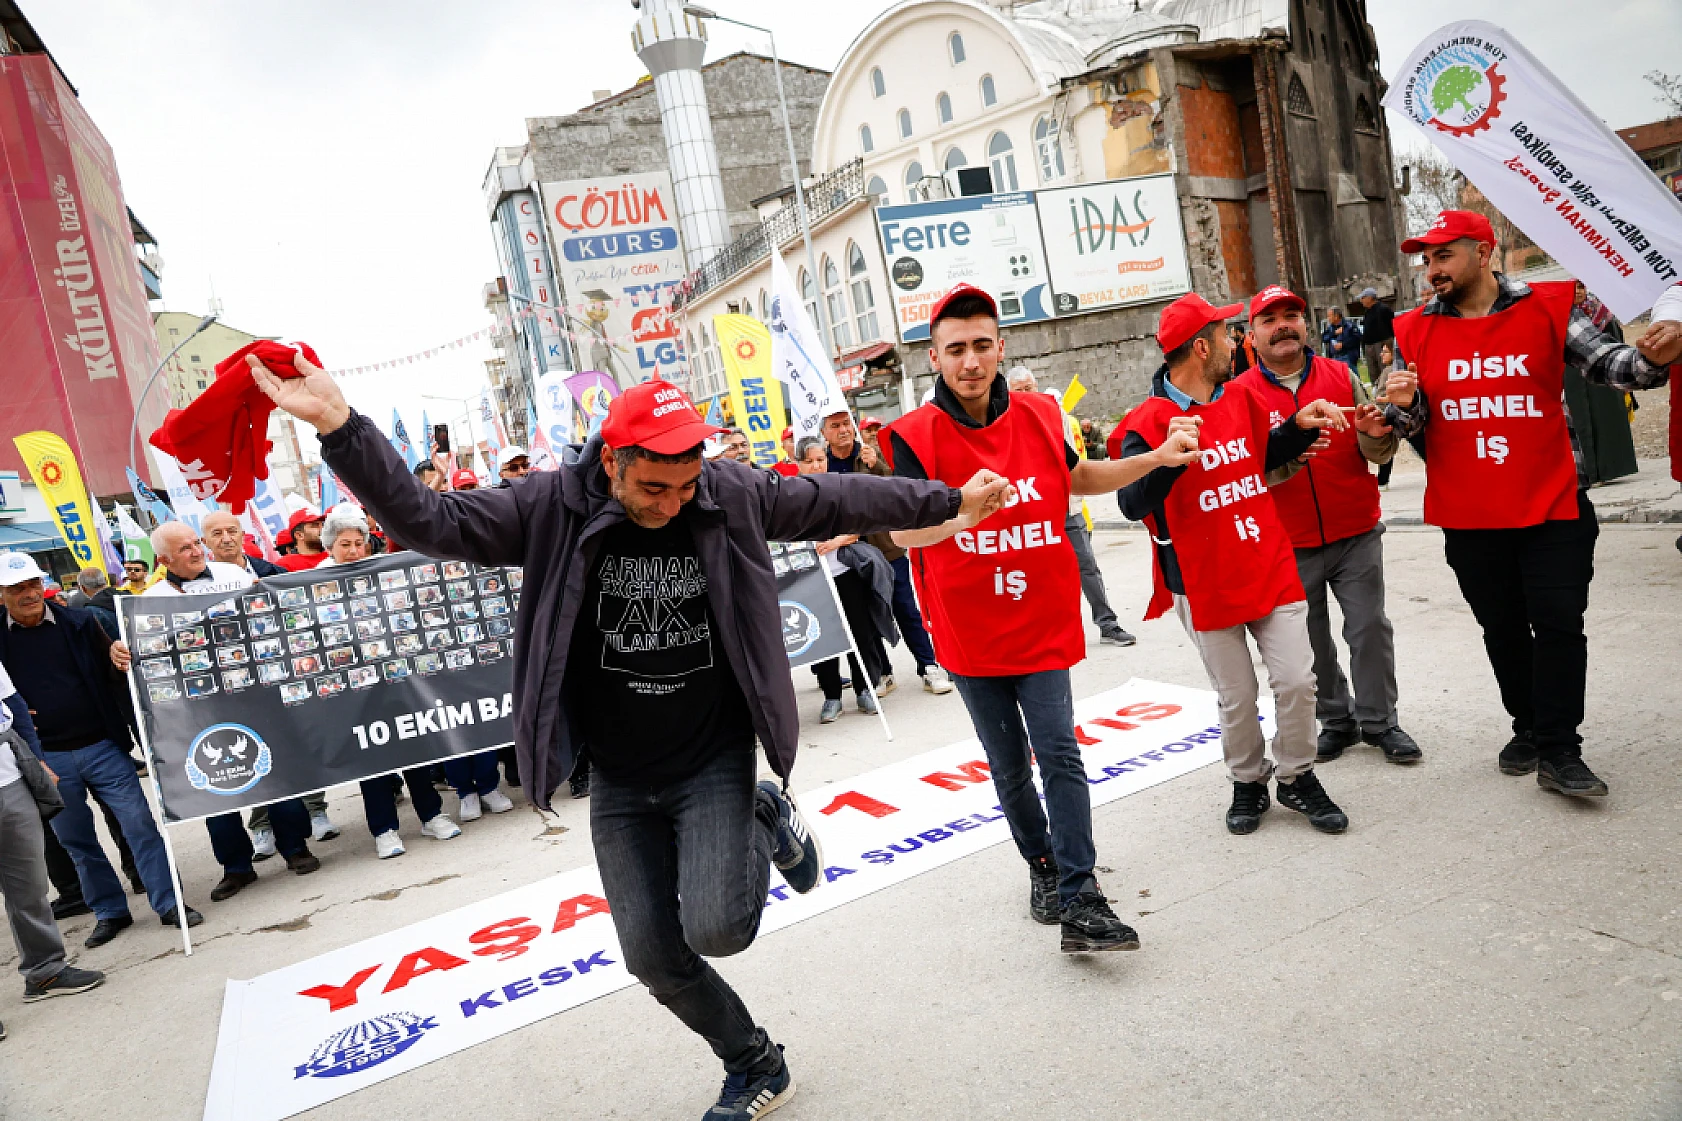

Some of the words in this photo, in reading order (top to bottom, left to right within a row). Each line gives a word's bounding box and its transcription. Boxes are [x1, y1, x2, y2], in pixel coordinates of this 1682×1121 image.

[56, 193, 82, 232] ÖZEL
[555, 182, 669, 235] ÇÖZÜM
[1070, 189, 1151, 256] İDAŞ
[578, 231, 665, 259] KURS
[882, 221, 971, 255] Ferre
[54, 235, 119, 383] KÜLTÜR
[1079, 288, 1115, 305] BEYAZ
[1447, 351, 1531, 382] DİSK
[1440, 394, 1544, 421] GENEL
[1200, 437, 1252, 472] DİSK
[1475, 430, 1510, 465] İŞ
[1198, 473, 1268, 512] GENEL
[954, 520, 1062, 555] GENEL
[1233, 514, 1261, 542] İŞ
[993, 566, 1028, 601] İŞ
[352, 720, 390, 750] 10
[394, 698, 475, 741] EKİM
[918, 701, 1183, 792] MYIS
[459, 949, 617, 1018] KESK
[293, 1014, 440, 1080] KESK
